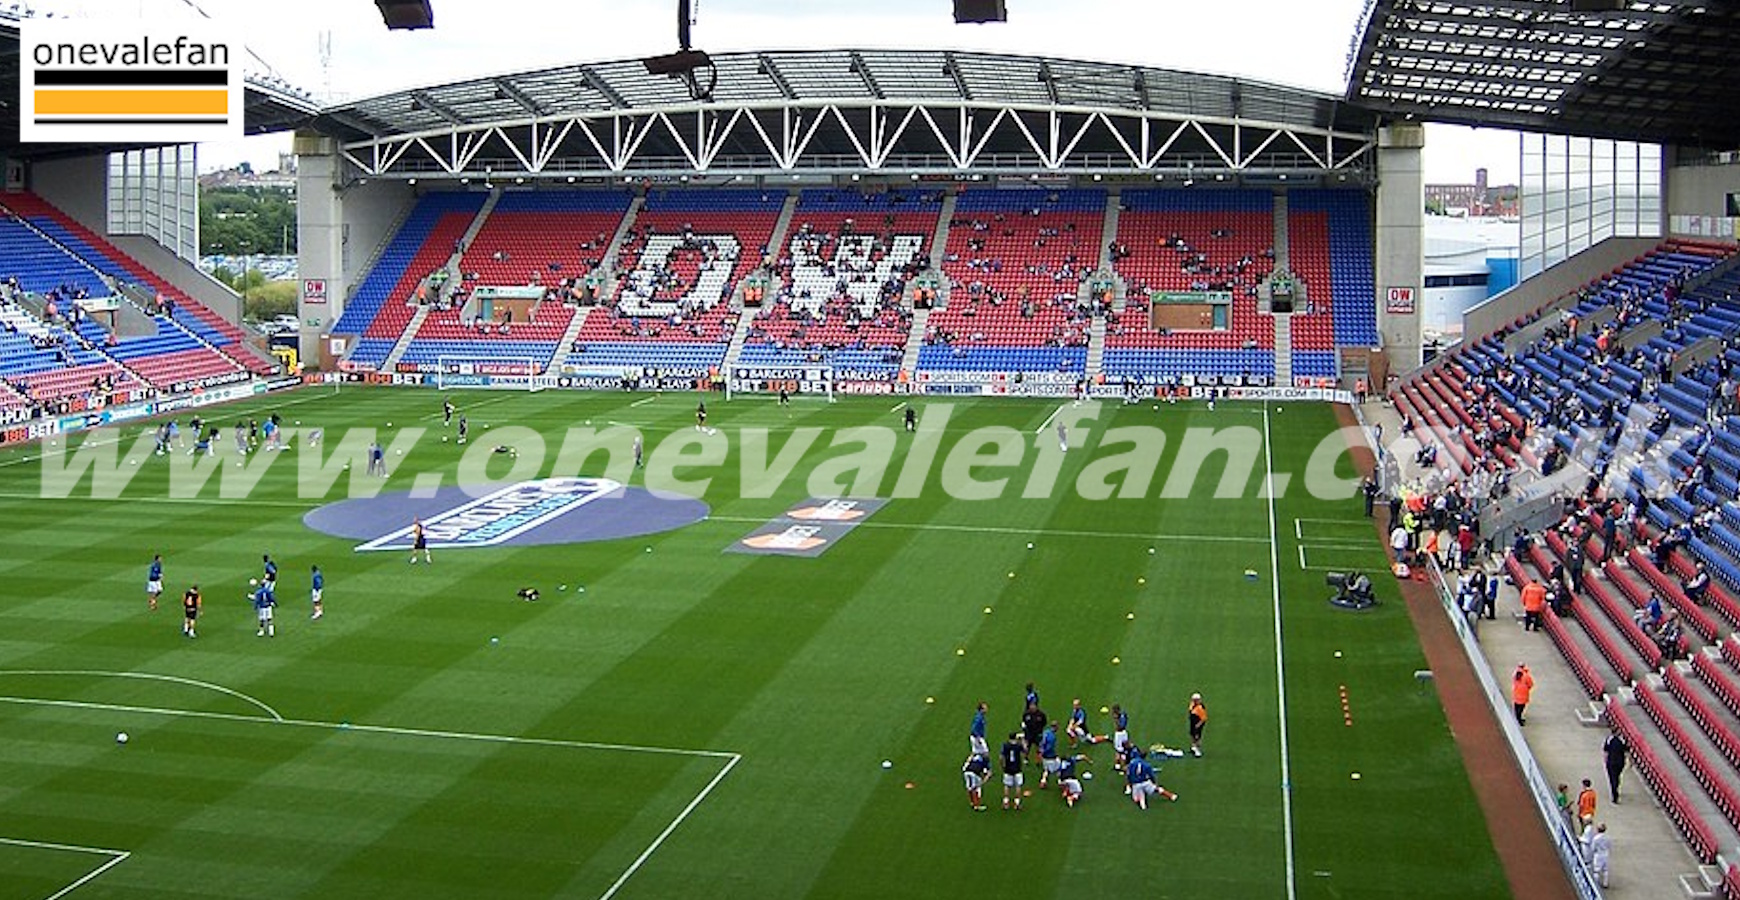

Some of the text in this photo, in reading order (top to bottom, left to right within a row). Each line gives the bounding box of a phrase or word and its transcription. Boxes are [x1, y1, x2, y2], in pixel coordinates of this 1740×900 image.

[617, 233, 926, 320] DW
[393, 373, 423, 385] BET
[749, 369, 803, 380] BARCLAYS
[571, 377, 623, 389] BARCLAYS
